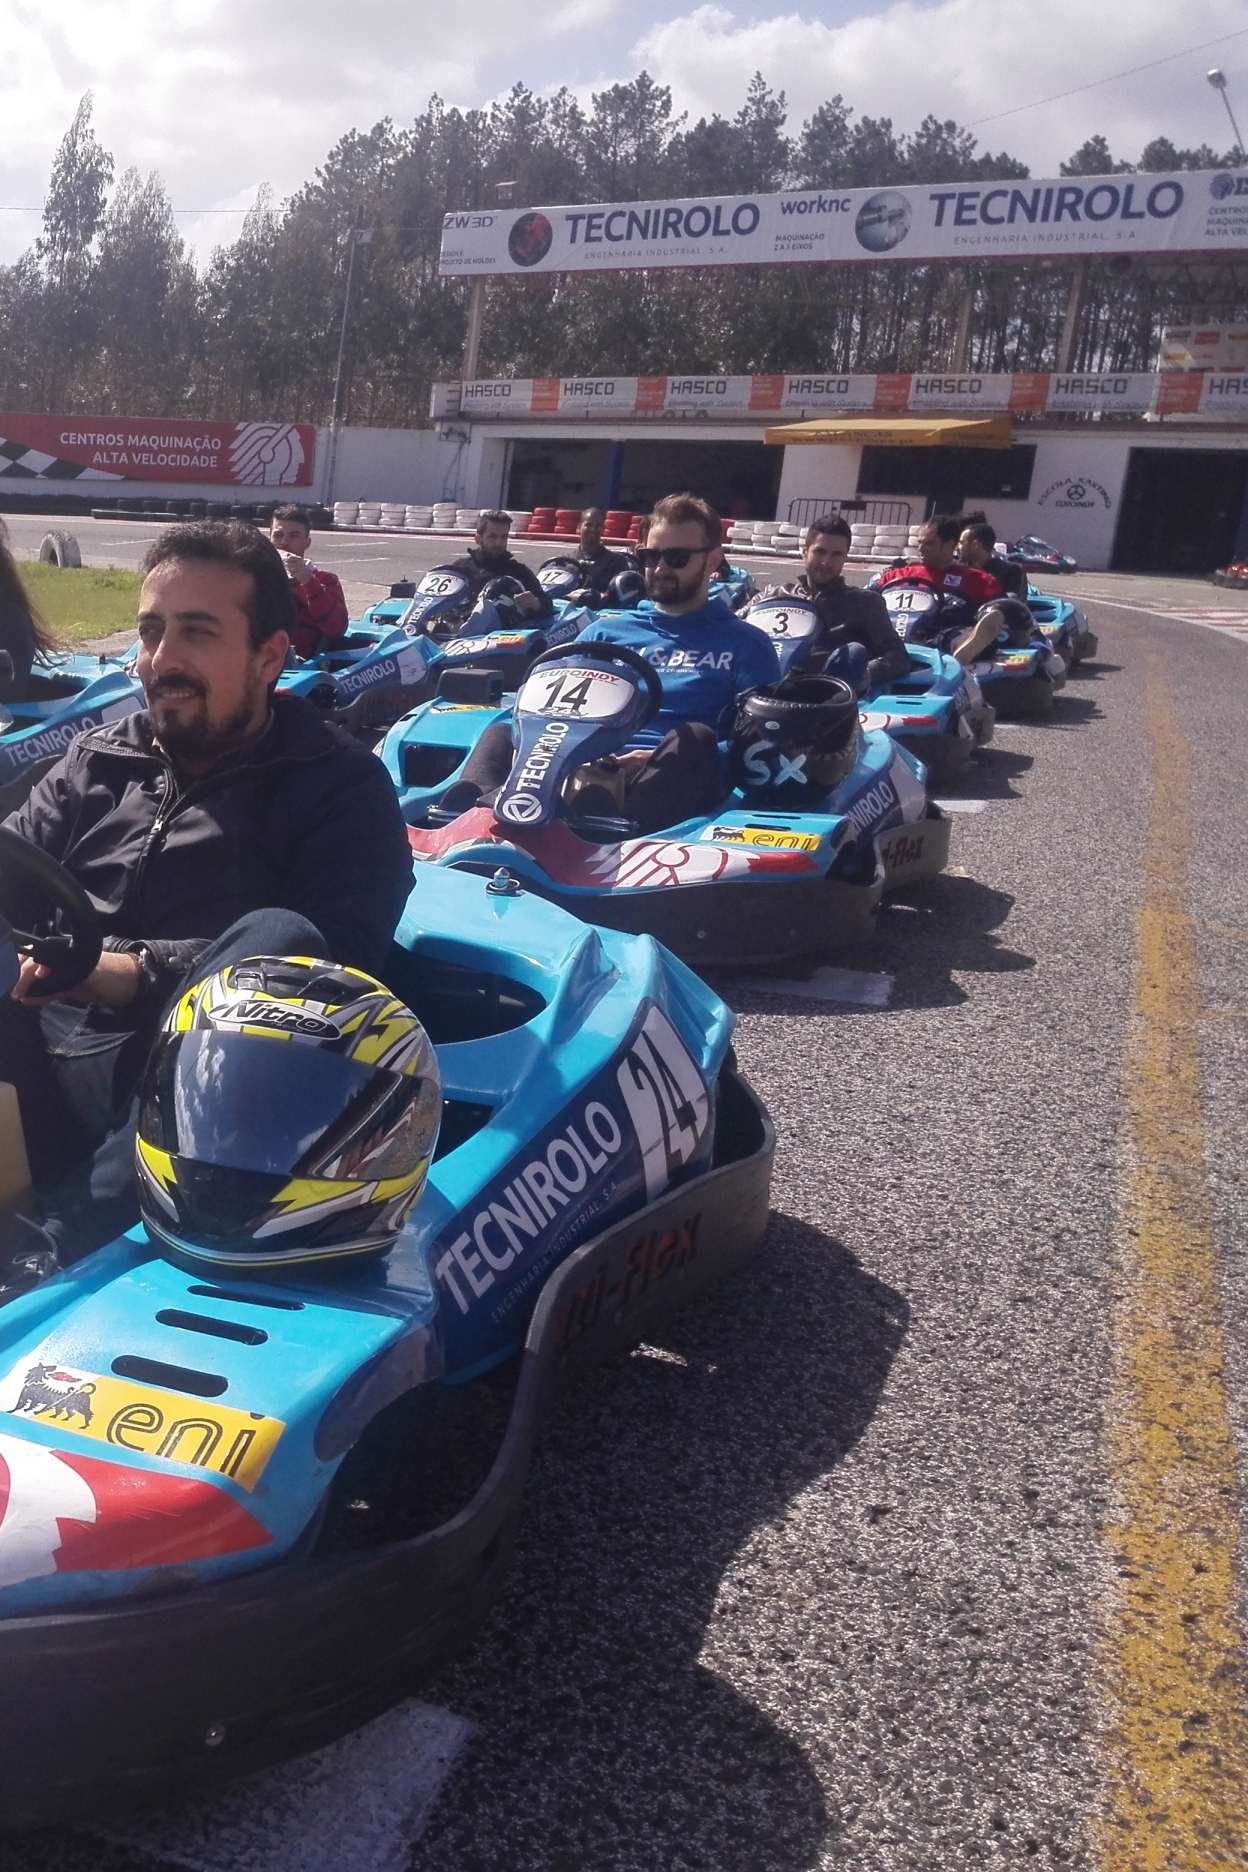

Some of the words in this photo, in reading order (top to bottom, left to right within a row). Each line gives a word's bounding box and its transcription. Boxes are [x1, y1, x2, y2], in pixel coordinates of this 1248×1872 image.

[781, 195, 851, 214] worknc
[929, 181, 1185, 227] TECNIROLO
[565, 203, 760, 244] TECNIROLO
[953, 234, 1028, 245] ENGENHARIA
[584, 250, 641, 260] ENGENHARIA
[465, 384, 512, 398] HASCO
[564, 382, 615, 396] HASCO
[670, 380, 727, 395] HASCO
[788, 380, 849, 394] HASCO
[915, 379, 982, 394] HASCO
[1055, 378, 1128, 395] HASCO
[60, 432, 125, 446] CENTROS
[128, 434, 222, 452] MAQUINAÇÃO
[92, 452, 129, 465] ALTA
[132, 453, 218, 468] VELOCIDADE
[424, 577, 452, 593] 26
[543, 572, 563, 582] 17
[895, 593, 914, 609] 11
[772, 612, 790, 634] 3
[340, 659, 396, 694] TECNIROLO
[538, 668, 620, 683] EUROINDY
[545, 673, 594, 712] 14
[515, 722, 570, 792] TECNIROLO
[753, 833, 815, 851] eni
[223, 999, 329, 1032] Nitro
[629, 1030, 701, 1184] 24
[435, 1101, 622, 1315] TECNIROLO
[106, 1402, 266, 1480] eni
